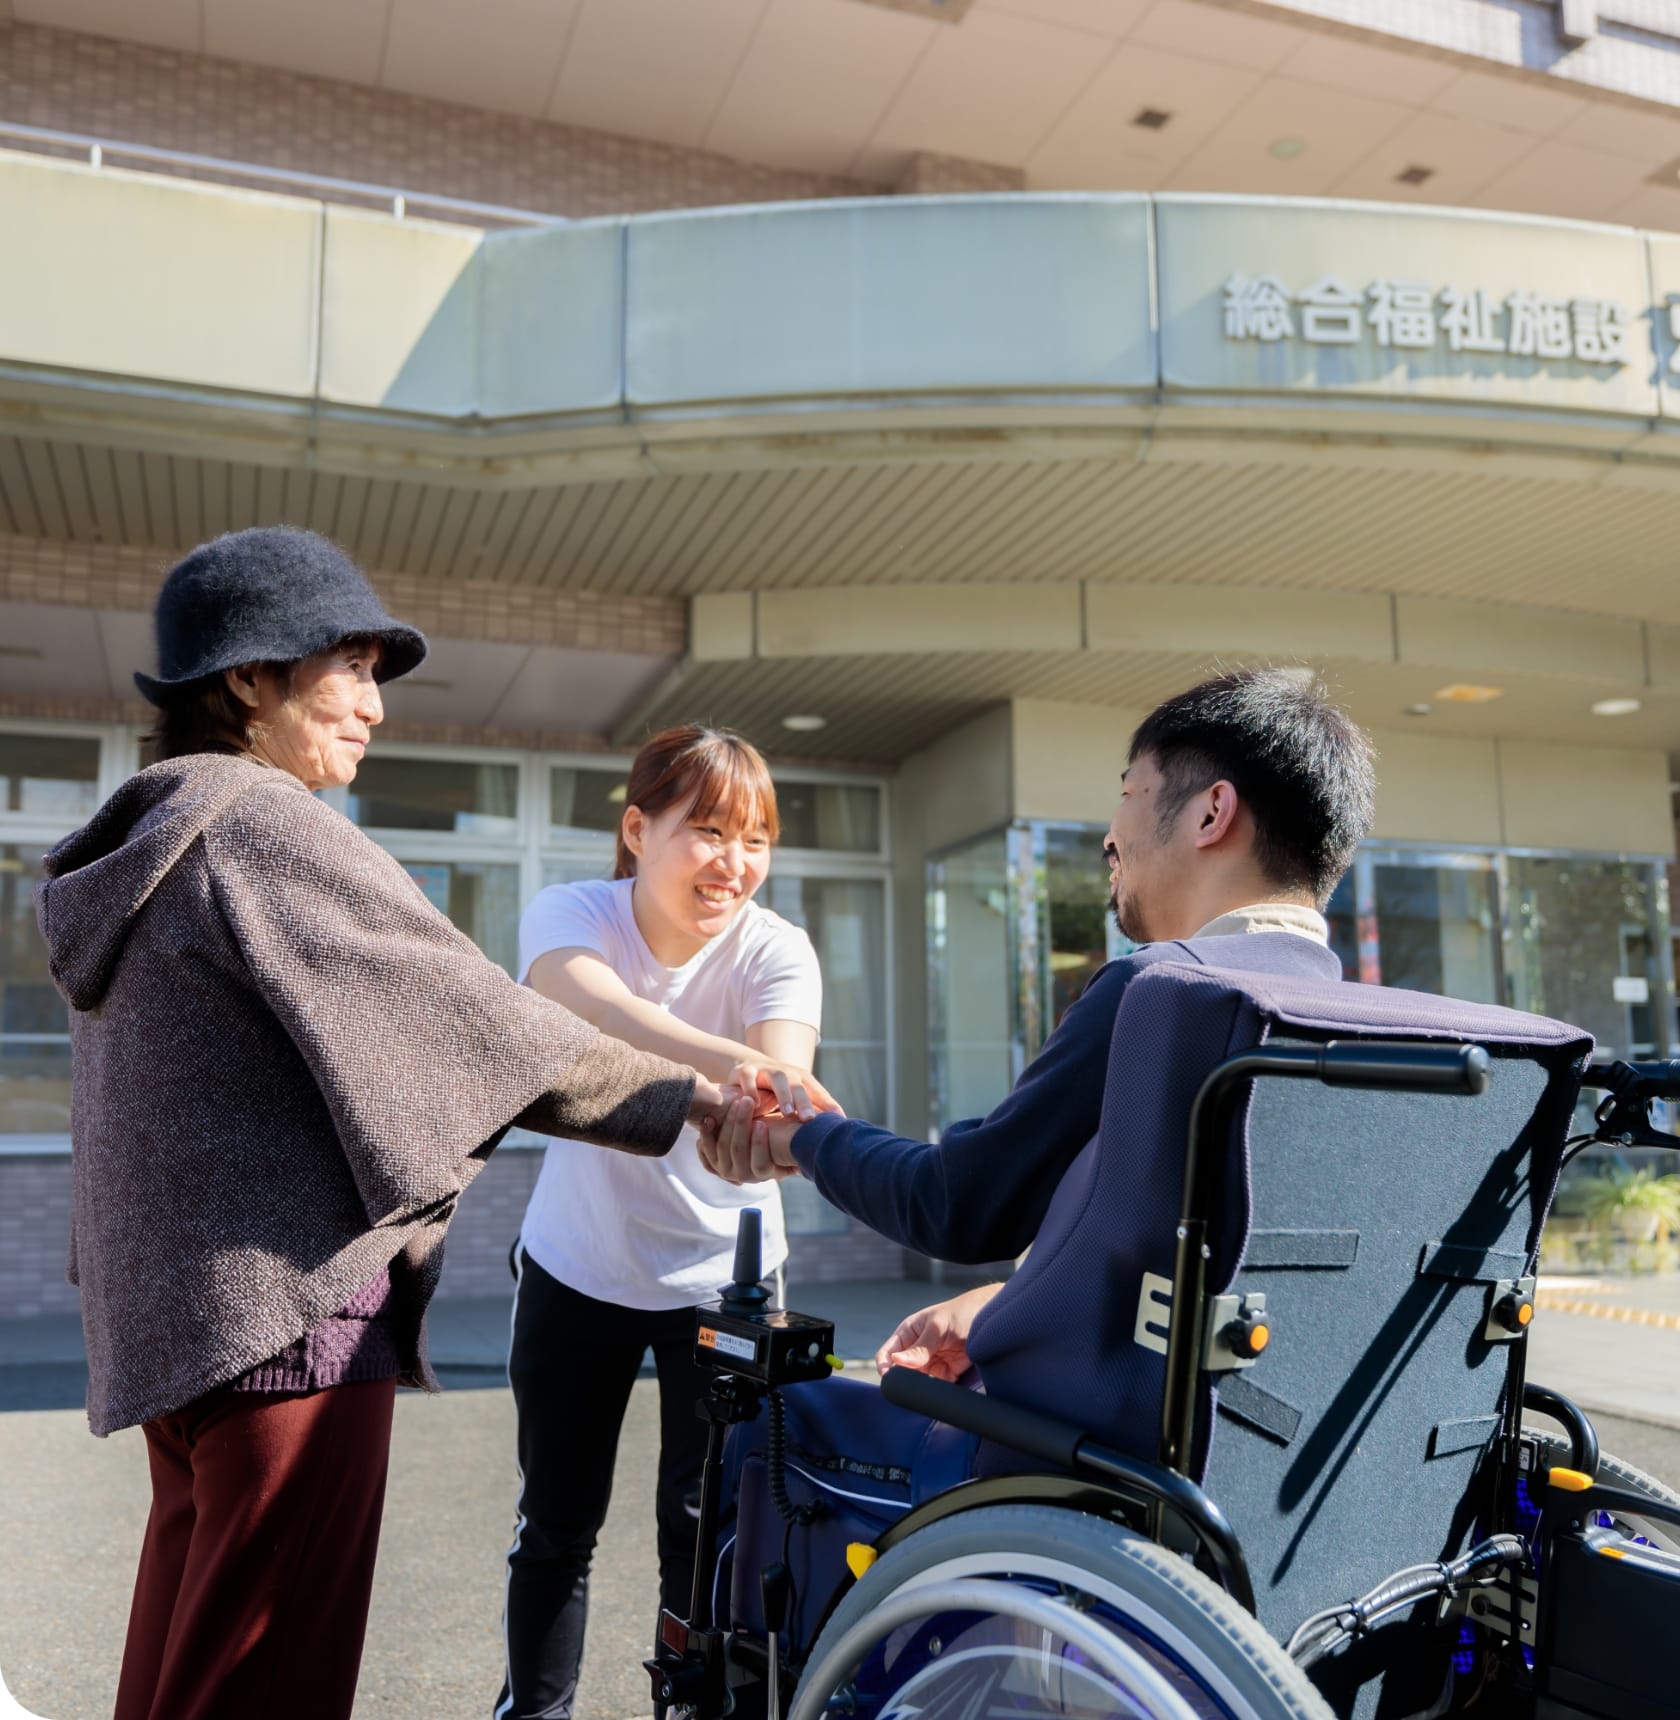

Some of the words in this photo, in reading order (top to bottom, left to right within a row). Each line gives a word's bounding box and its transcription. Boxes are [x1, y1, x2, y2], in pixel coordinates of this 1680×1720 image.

[1222, 272, 1629, 365] 総合福祉施設
